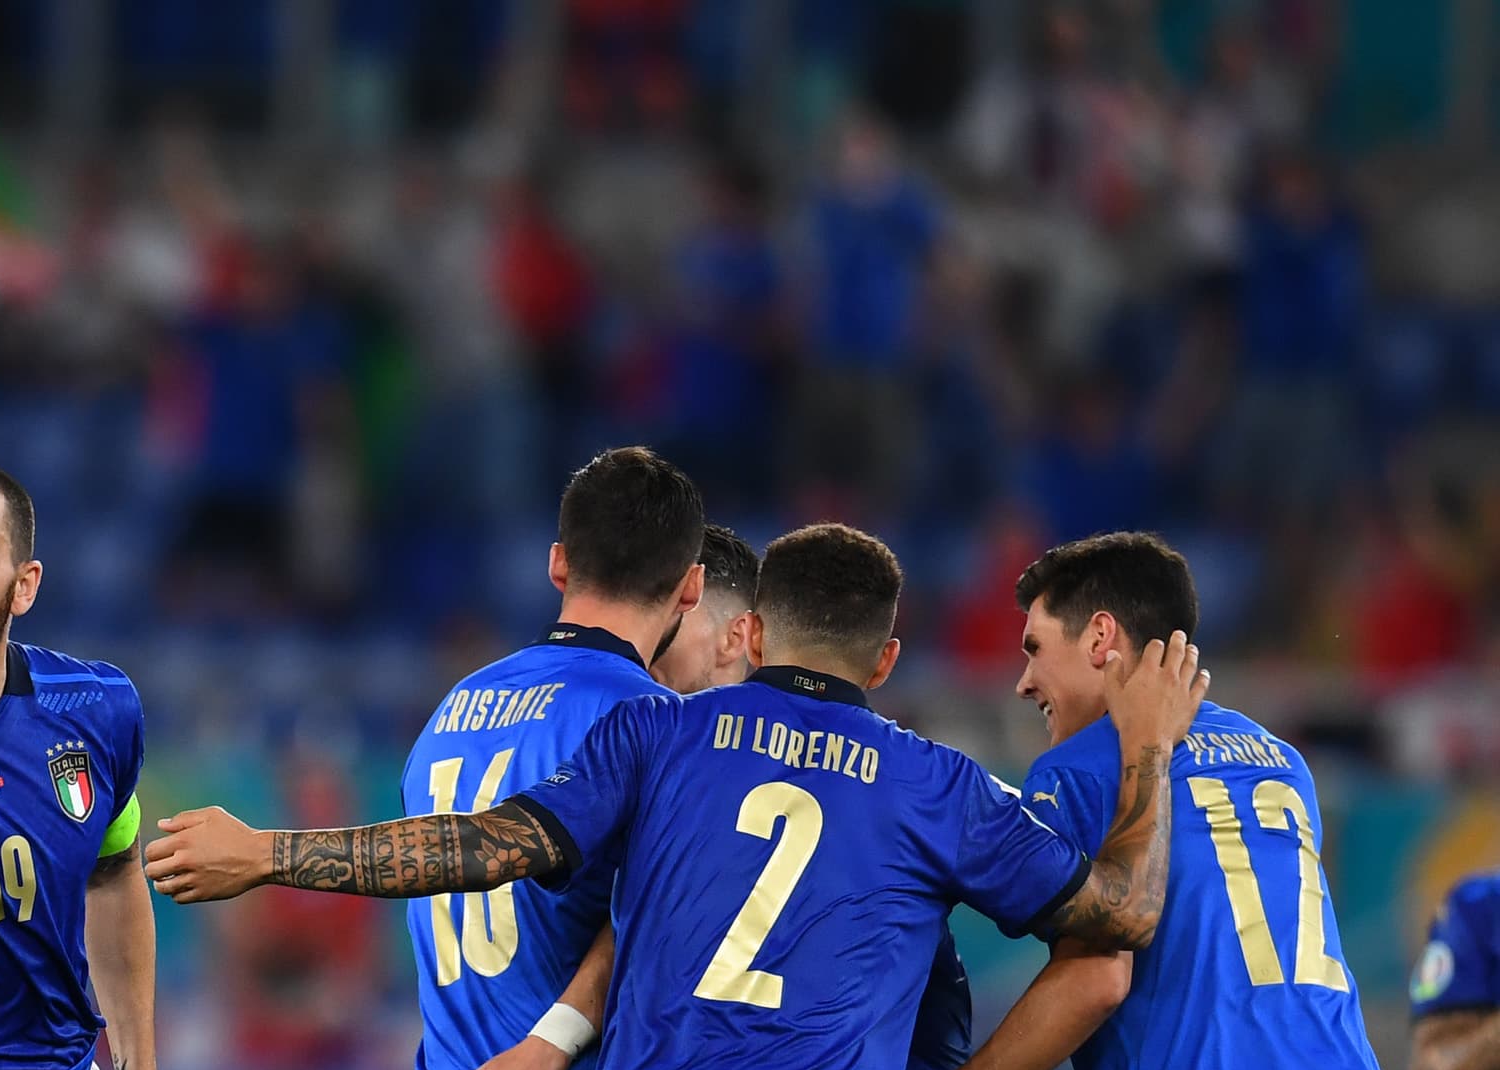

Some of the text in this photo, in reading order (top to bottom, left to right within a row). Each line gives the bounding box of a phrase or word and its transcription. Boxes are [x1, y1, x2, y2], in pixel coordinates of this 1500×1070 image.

[434, 682, 565, 734] CRISTANTE
[794, 674, 826, 691] ITALIA
[52, 757, 85, 774] ITALIA
[713, 714, 879, 784] DI LORENZO
[428, 748, 518, 986] 16
[693, 781, 824, 1009] 2
[1186, 777, 1350, 993] 12
